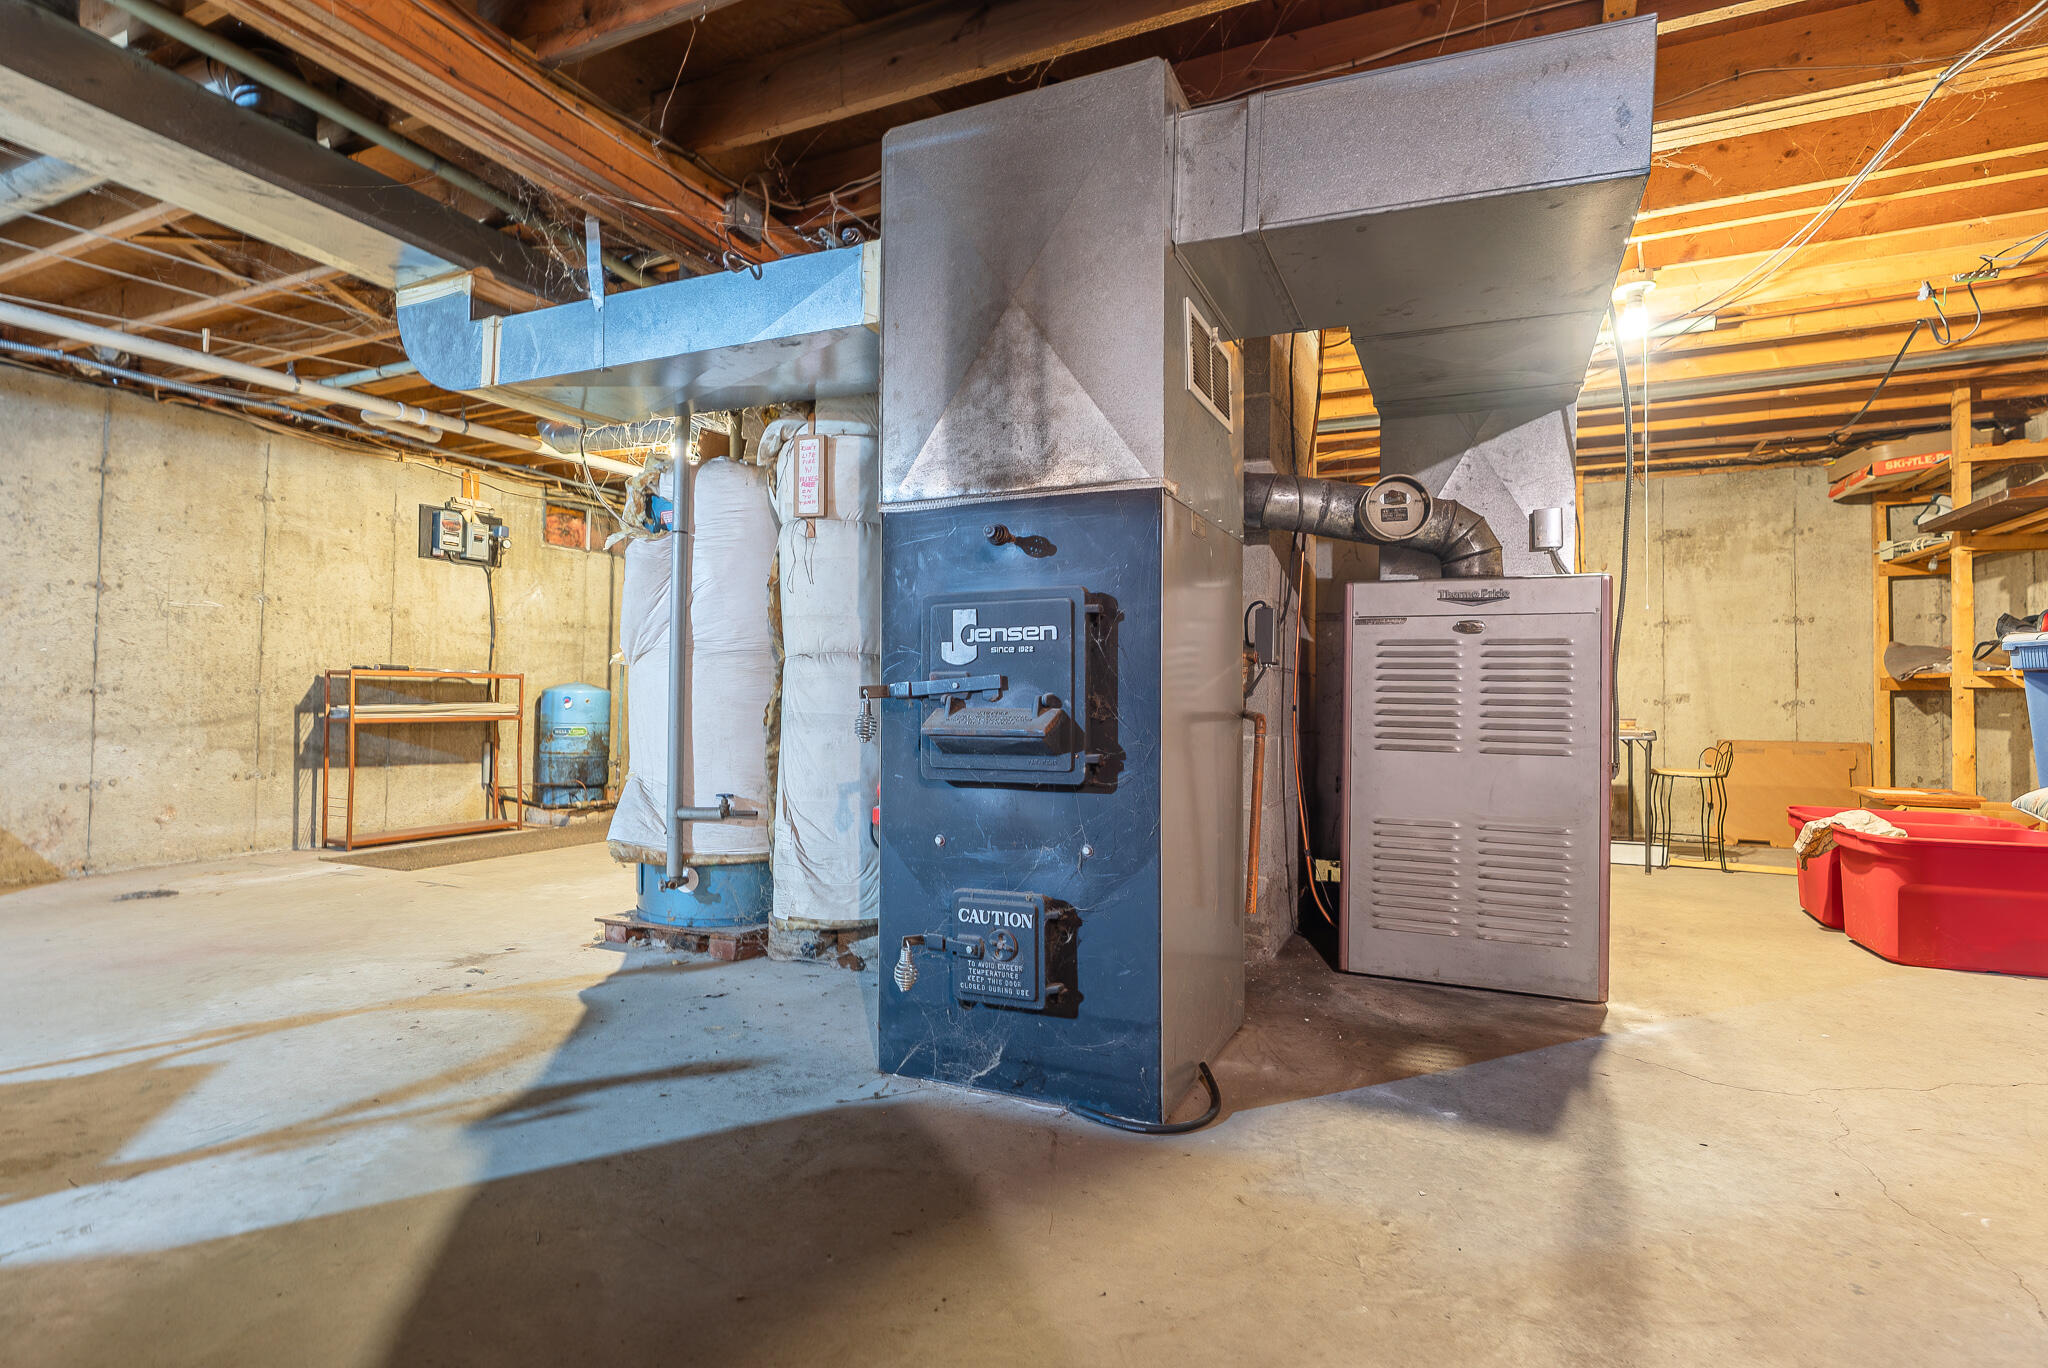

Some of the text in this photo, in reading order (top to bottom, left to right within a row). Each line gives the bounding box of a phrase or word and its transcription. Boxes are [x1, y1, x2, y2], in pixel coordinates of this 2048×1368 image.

[958, 908, 1033, 929] CAUTION
[978, 962, 995, 970] AVOID
[968, 967, 1019, 980] TEMPERATURES
[967, 975, 1021, 988] KEEP THIS DOOR
[960, 982, 986, 991] CLOSED
[988, 985, 1013, 995] DURING
